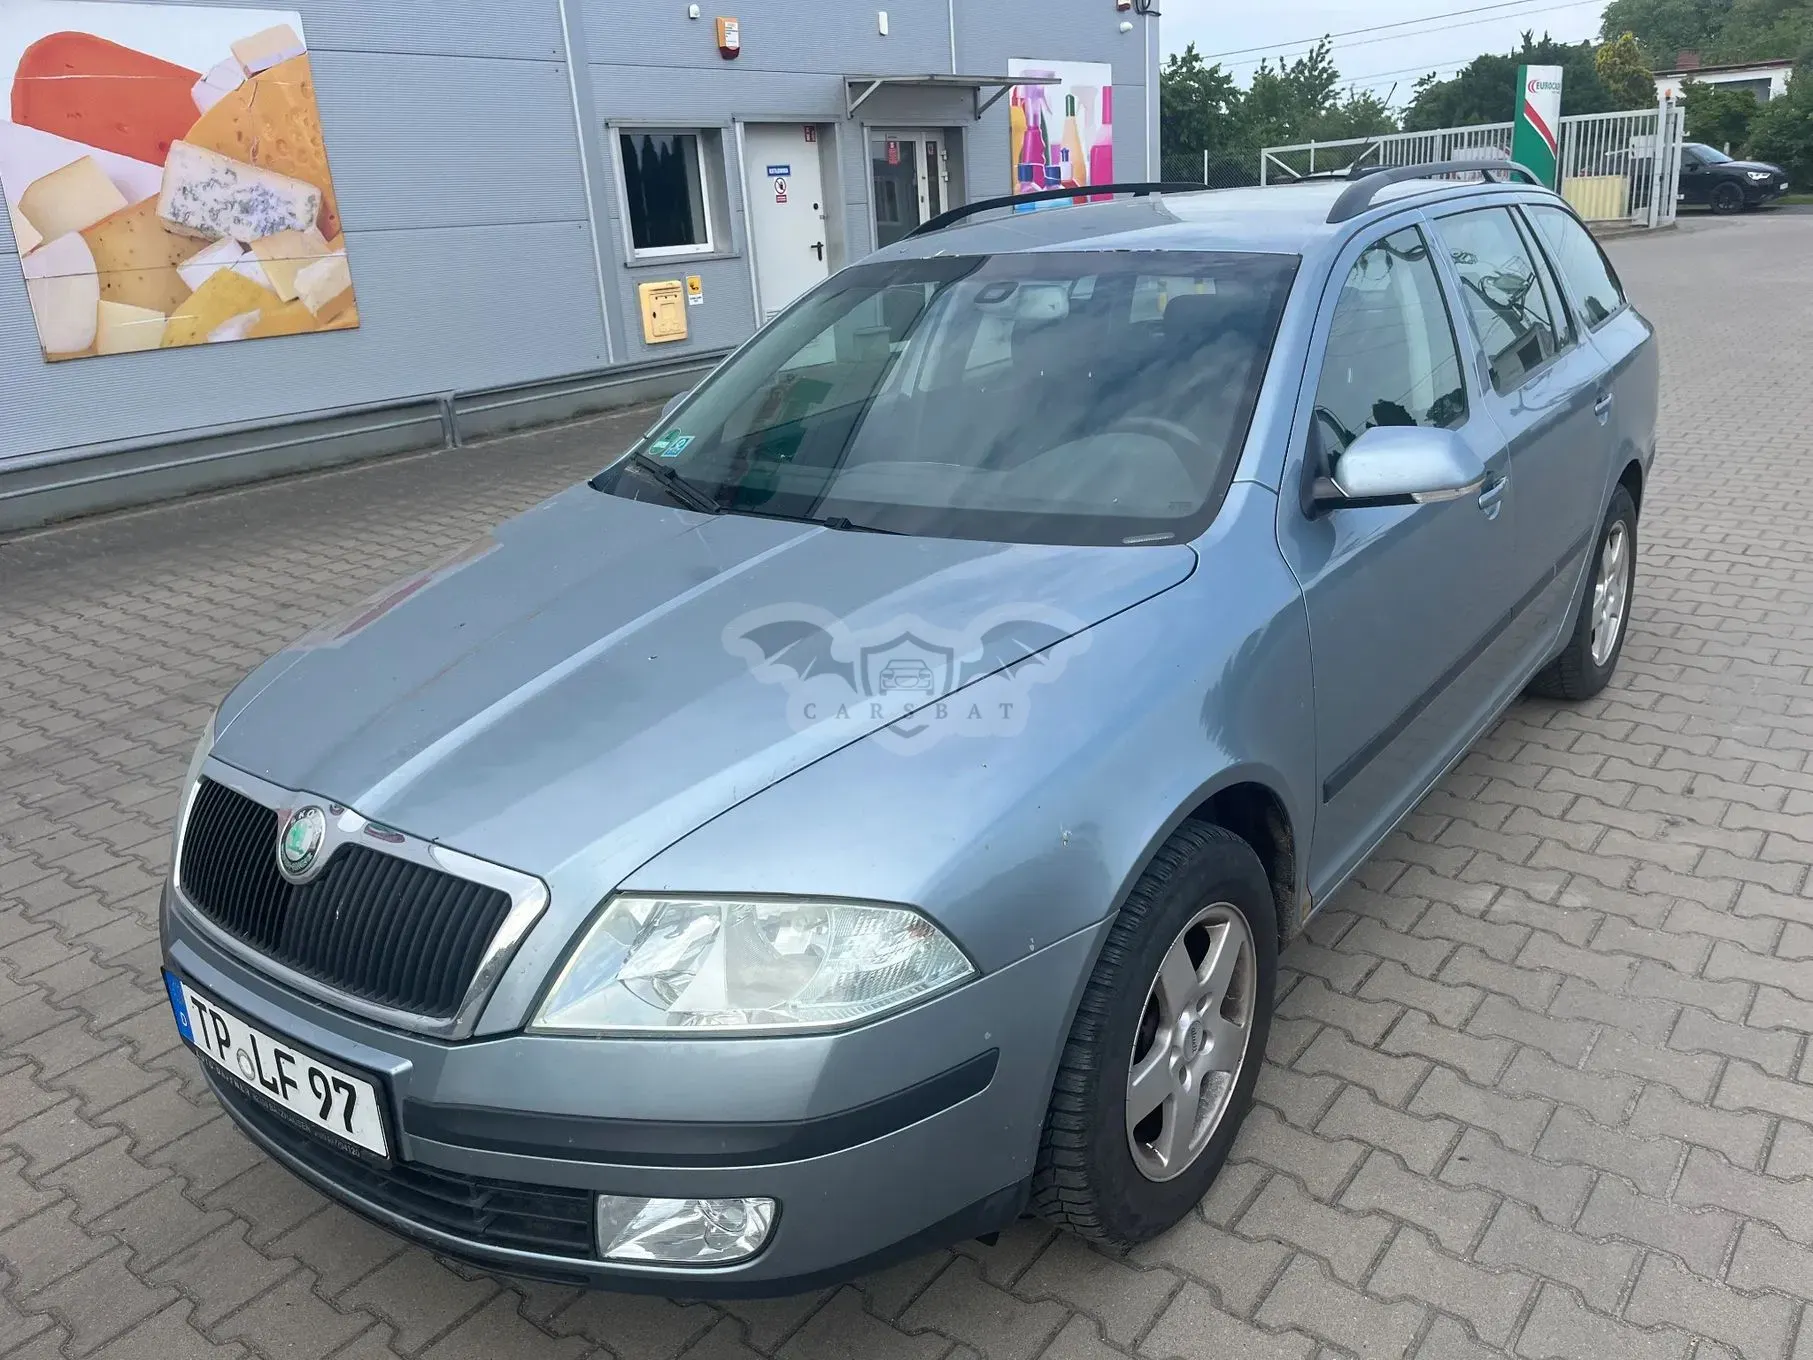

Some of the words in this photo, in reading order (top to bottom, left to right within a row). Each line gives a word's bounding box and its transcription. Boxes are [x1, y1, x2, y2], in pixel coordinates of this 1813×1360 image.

[180, 1011, 188, 1027] D
[190, 995, 231, 1061] TP
[249, 1033, 298, 1101] LF
[307, 1066, 357, 1134] 97
